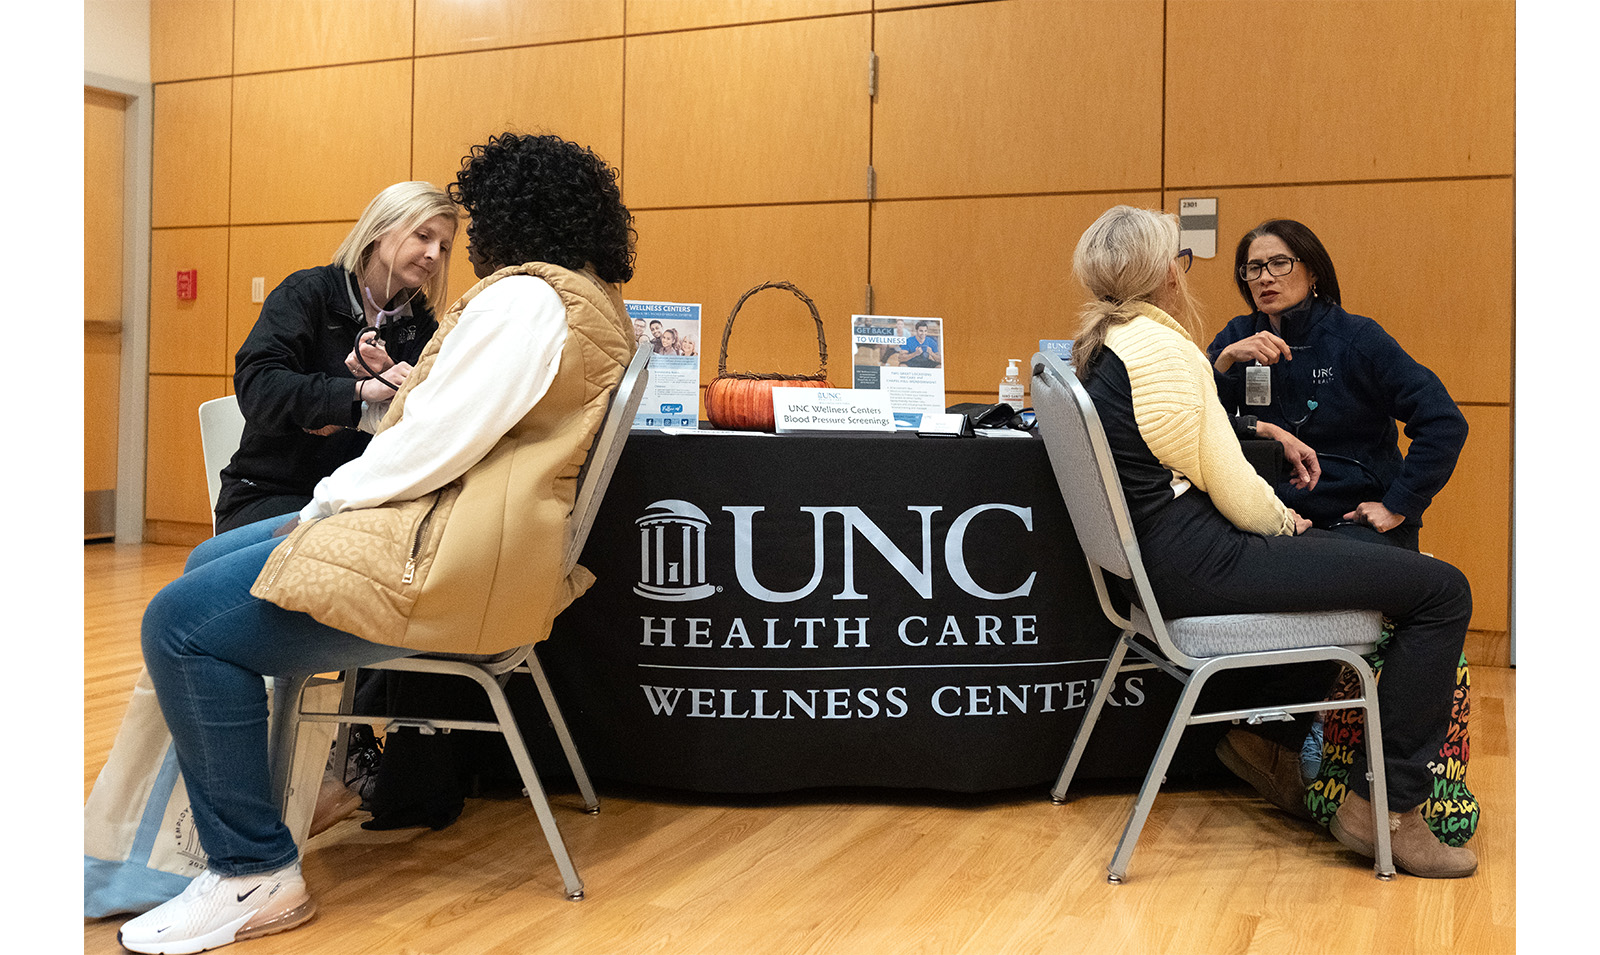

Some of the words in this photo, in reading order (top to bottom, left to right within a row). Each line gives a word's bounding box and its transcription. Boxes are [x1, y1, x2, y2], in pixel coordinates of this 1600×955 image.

[629, 304, 662, 312] WELLNESS
[868, 336, 906, 345] WELLNESS
[1051, 342, 1071, 350] UNC
[1312, 366, 1334, 378] UNC
[788, 404, 810, 413] UNC
[812, 404, 849, 414] Wellness
[850, 406, 882, 415] Centers
[783, 414, 810, 424] Blood
[812, 415, 846, 425] Pressure
[847, 416, 890, 427] Screenings
[721, 503, 1037, 602] UNC
[639, 615, 871, 649] HEALTH
[897, 614, 1039, 647] CARE
[639, 684, 909, 720] WELLNESS
[174, 807, 191, 840] EMPLOY
